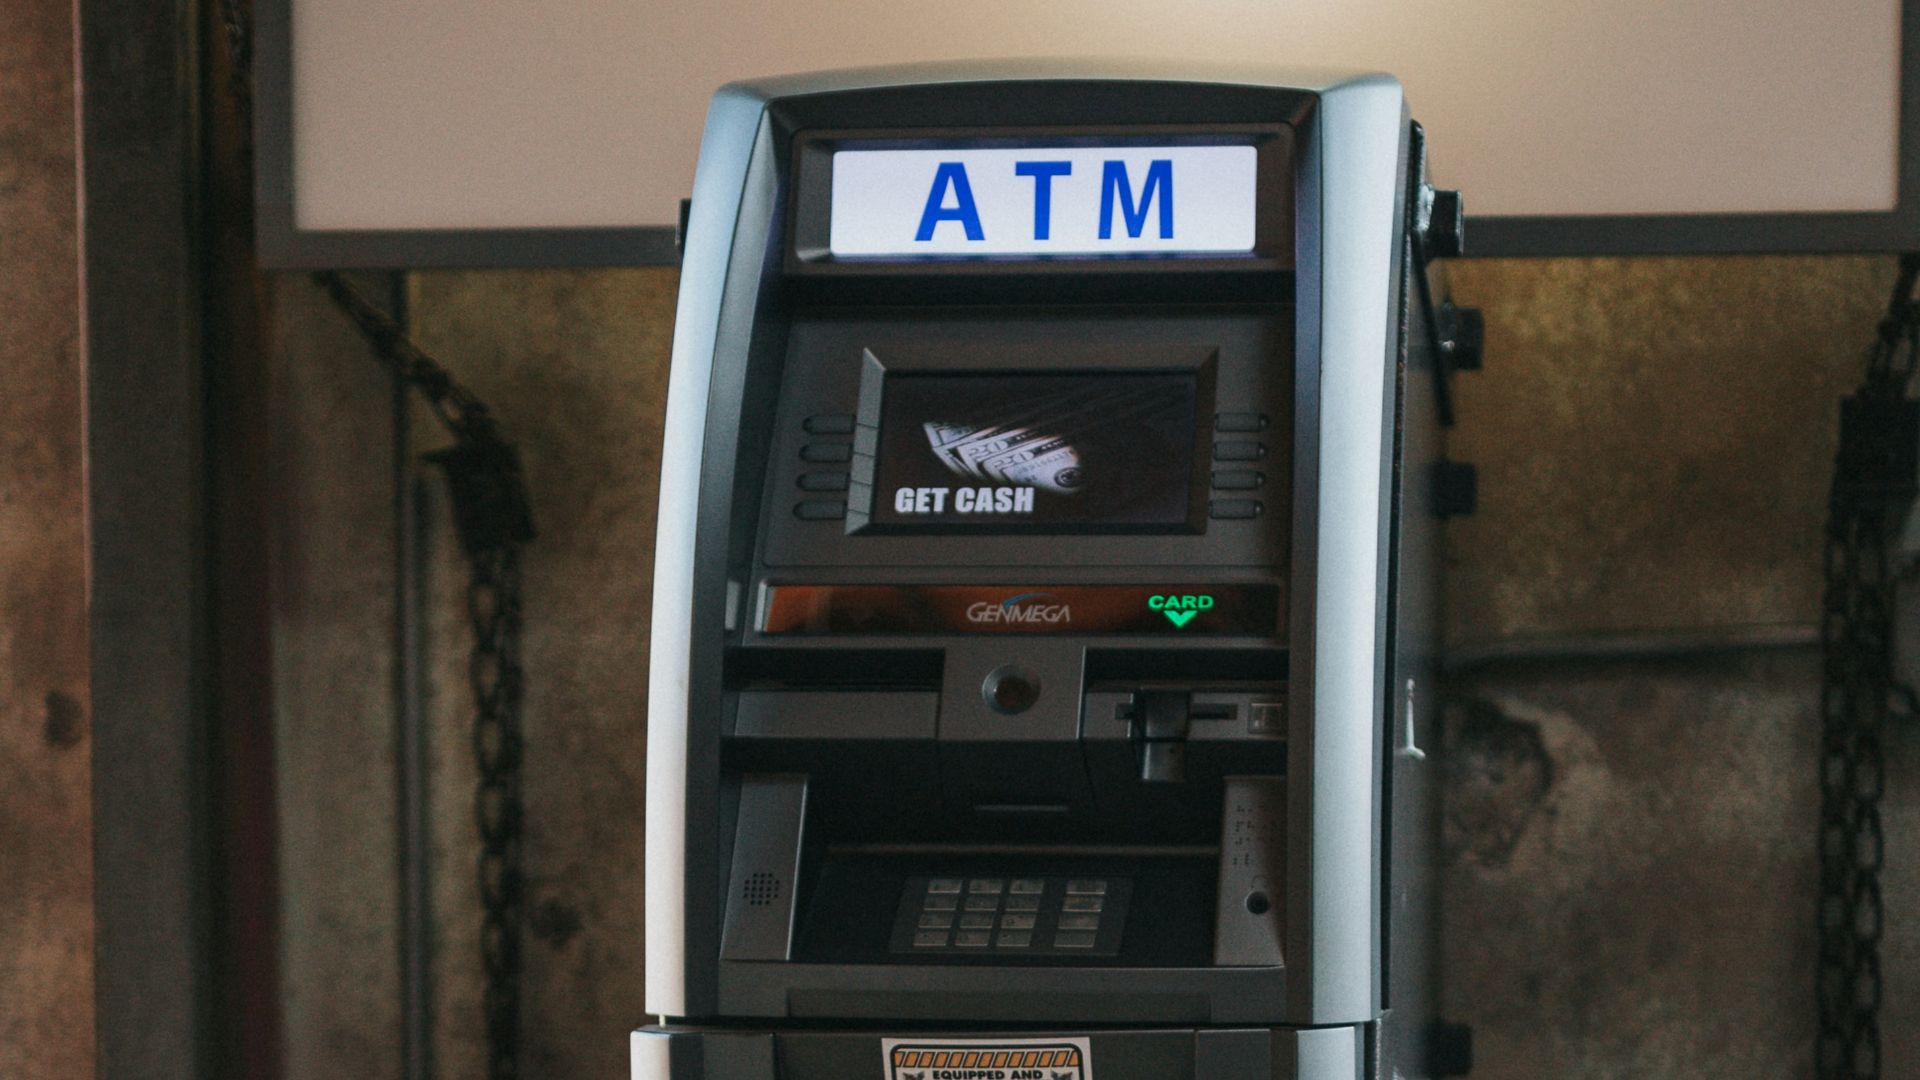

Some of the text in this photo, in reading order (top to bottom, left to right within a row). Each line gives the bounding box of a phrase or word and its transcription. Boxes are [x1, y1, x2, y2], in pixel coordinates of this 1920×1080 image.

[914, 160, 1174, 241] ATM
[894, 486, 1035, 513] GET CASH
[966, 601, 1071, 624] GENMEGA
[1147, 594, 1214, 610] CARD
[932, 1069, 1043, 1080] EQUIPPED AND
